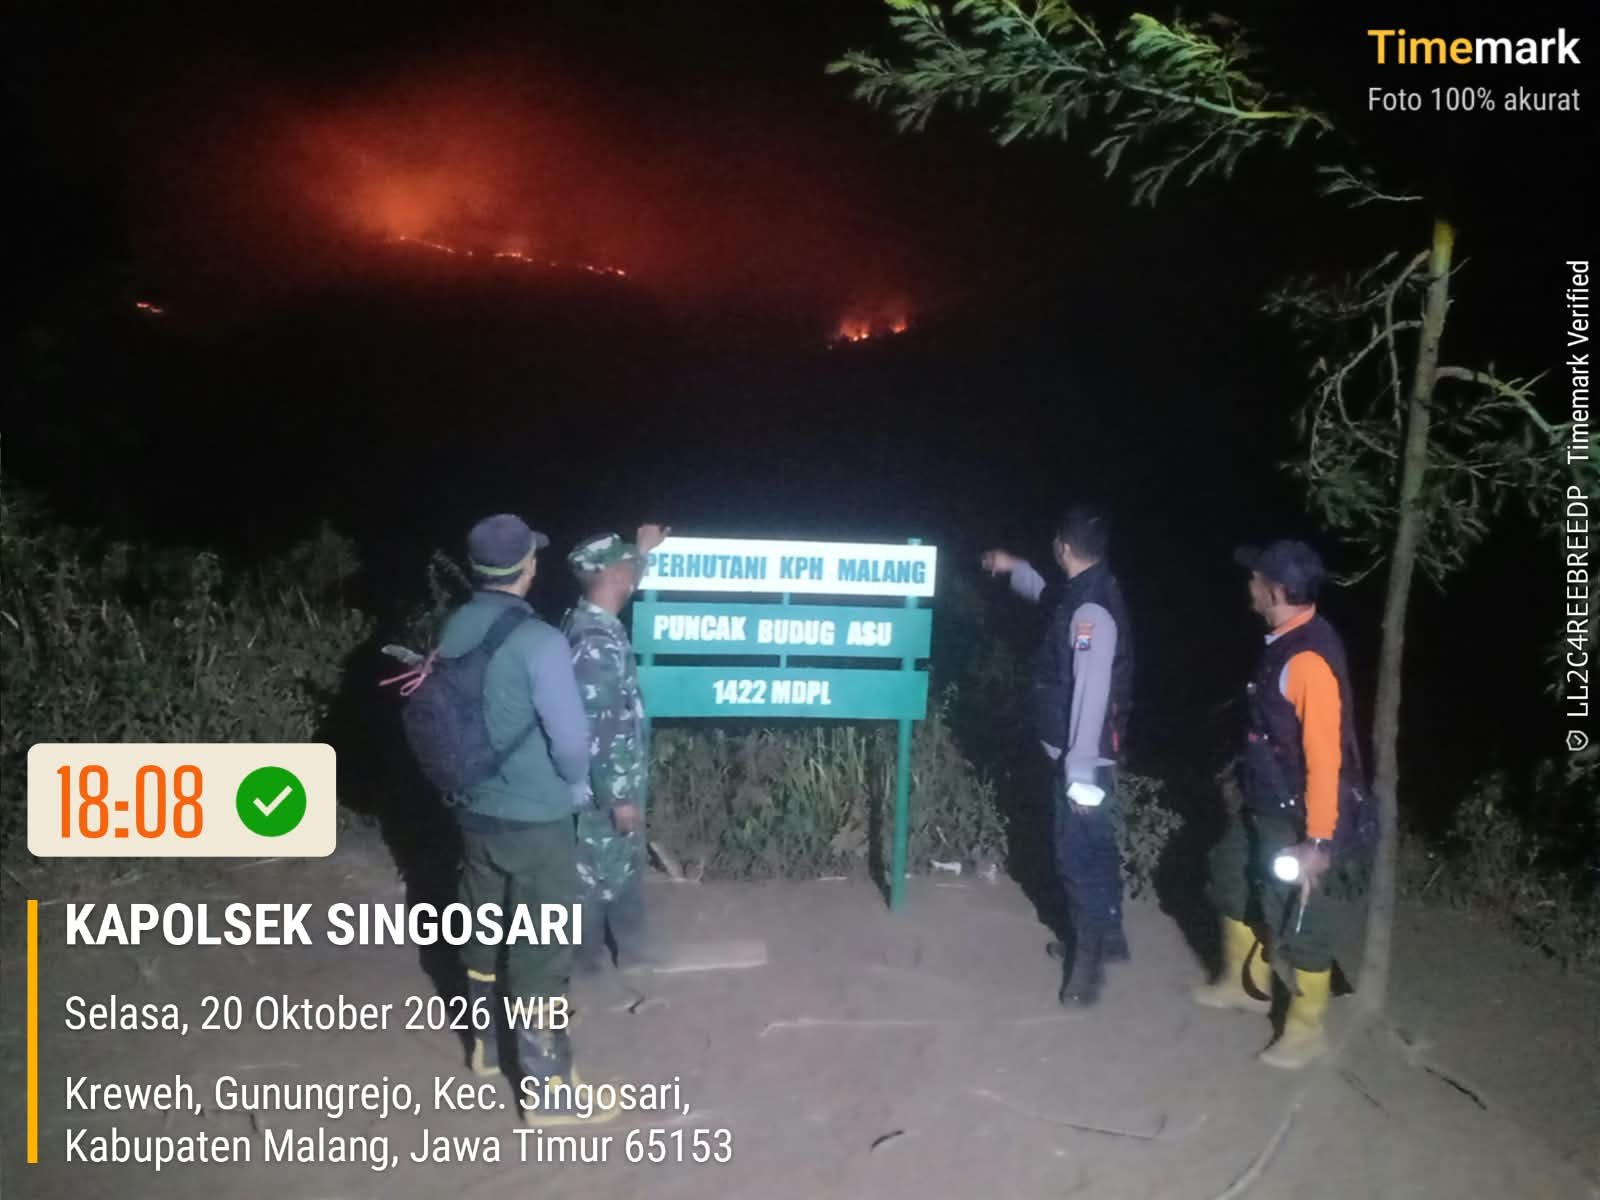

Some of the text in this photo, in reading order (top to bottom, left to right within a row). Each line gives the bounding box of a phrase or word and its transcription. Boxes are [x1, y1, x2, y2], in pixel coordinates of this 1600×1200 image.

[780, 556, 824, 581] KPH
[838, 558, 927, 585] MALANG
[653, 614, 892, 647] PUNCAK BUDUG ASU
[713, 679, 832, 706] 1422 MDPL
